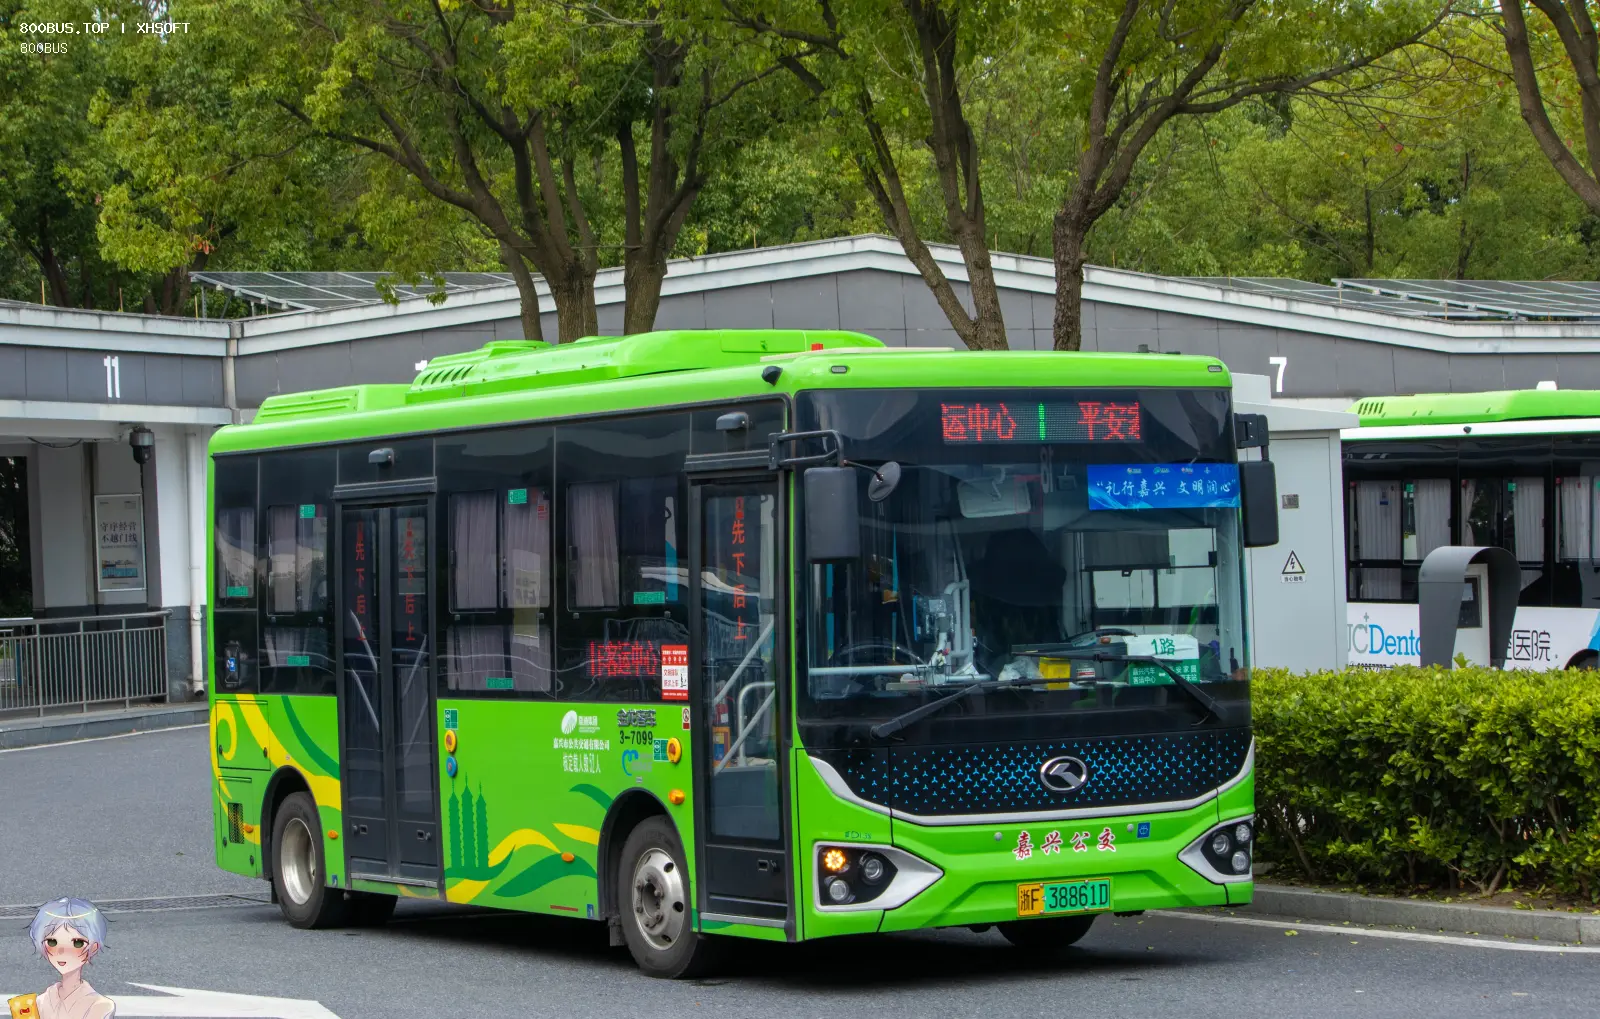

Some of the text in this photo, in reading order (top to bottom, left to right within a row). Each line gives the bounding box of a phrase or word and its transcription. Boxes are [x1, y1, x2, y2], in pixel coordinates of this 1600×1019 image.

[103, 355, 121, 399] 11
[1269, 356, 1287, 393] 7
[1506, 629, 1551, 662] 医院
[619, 729, 654, 746] 3-7099
[1013, 828, 1116, 860] 嘉兴公交
